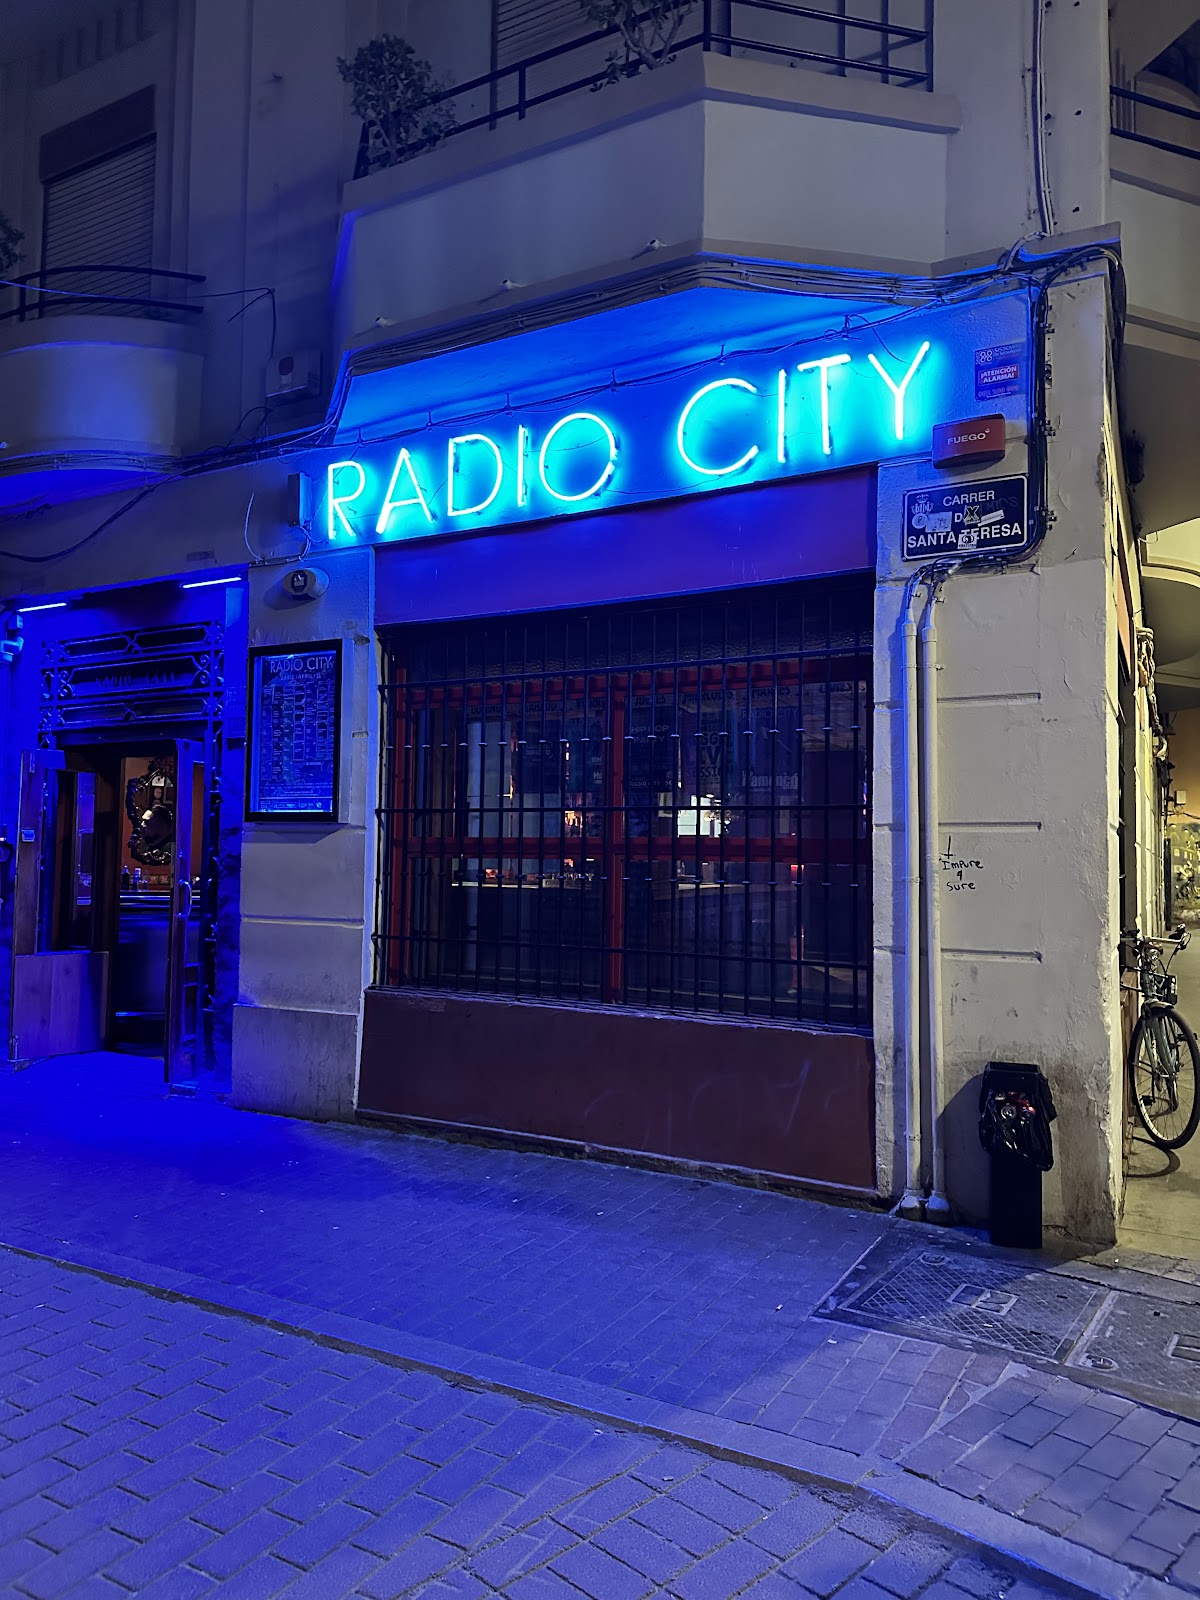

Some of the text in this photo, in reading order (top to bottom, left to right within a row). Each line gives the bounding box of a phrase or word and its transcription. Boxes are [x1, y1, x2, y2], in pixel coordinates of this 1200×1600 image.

[327, 341, 932, 542] RADIO CITY
[947, 432, 987, 446] FUEGO
[942, 490, 996, 507] CARRER
[907, 531, 958, 549] SANTA
[270, 656, 332, 674] RADIO CITY
[751, 687, 790, 698] MARES
[742, 707, 799, 719] RADIO CITY
[941, 860, 984, 870] Impure
